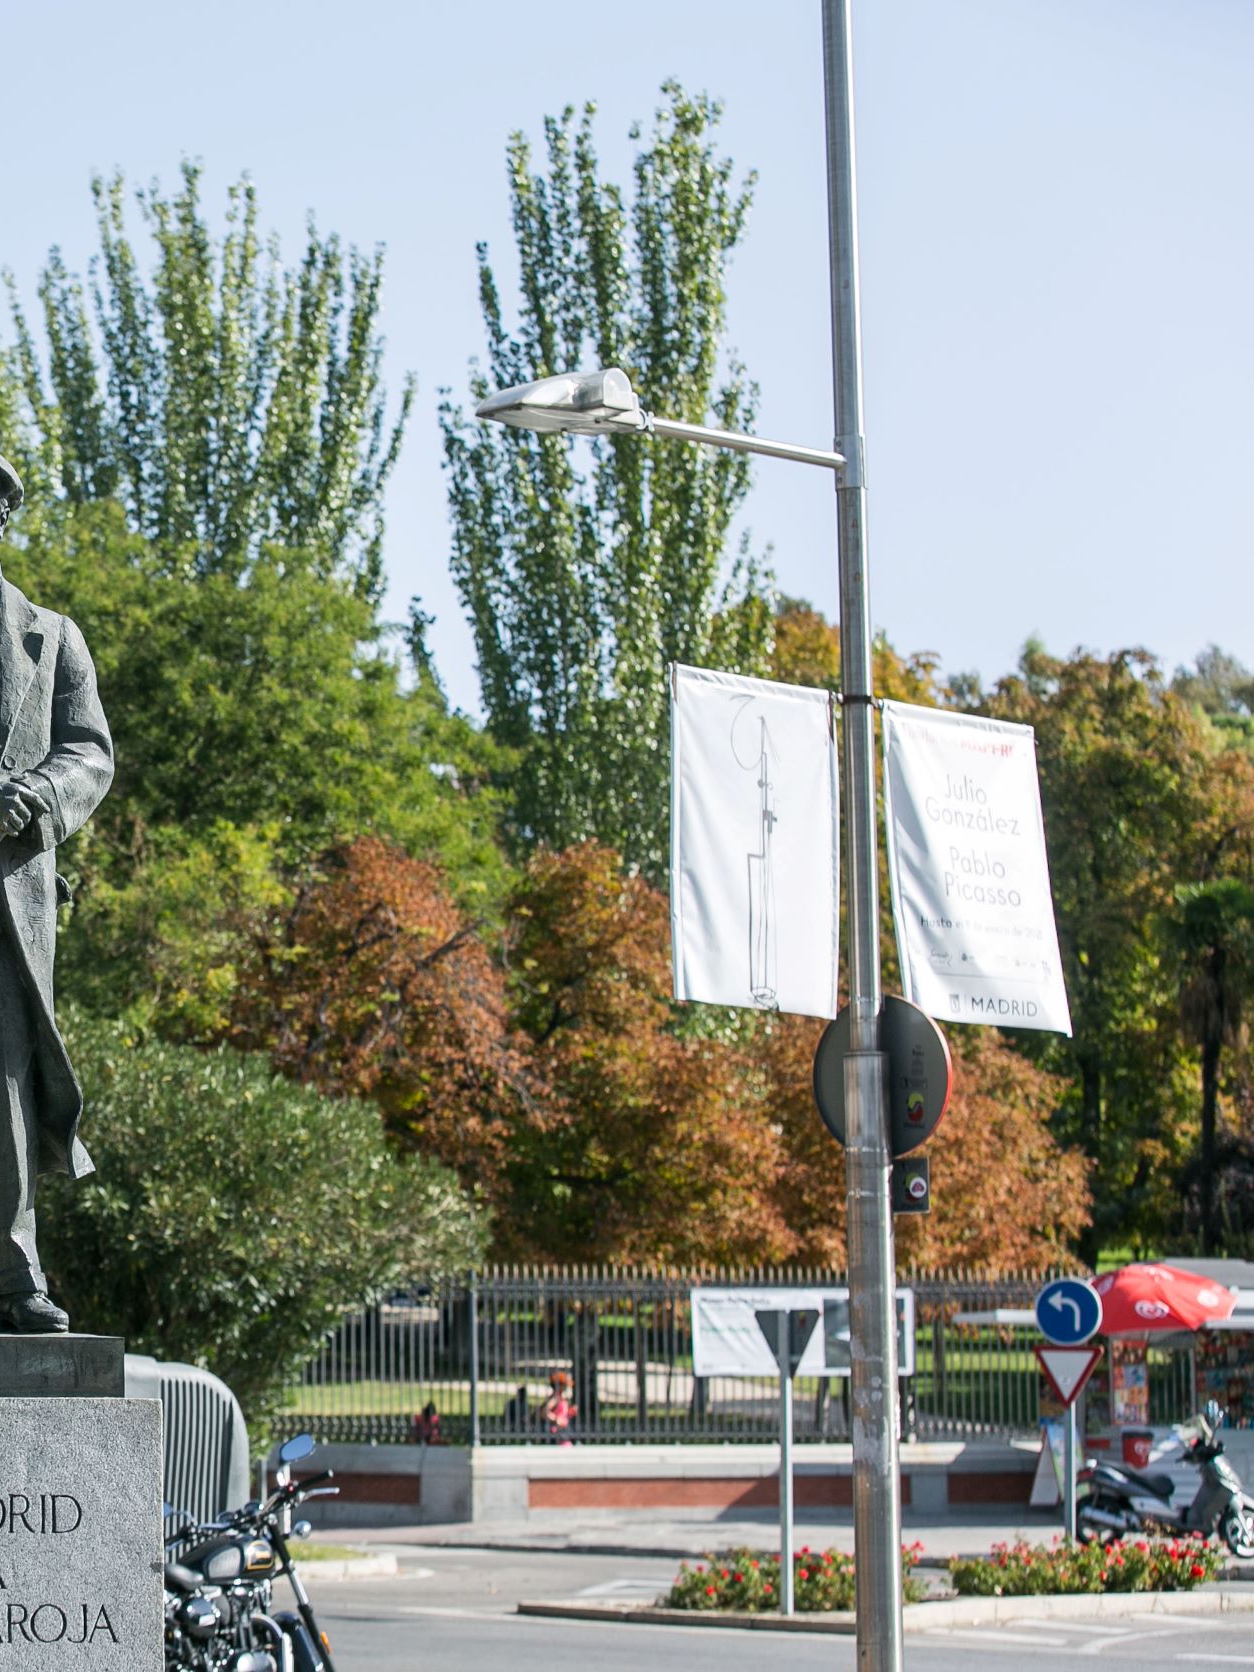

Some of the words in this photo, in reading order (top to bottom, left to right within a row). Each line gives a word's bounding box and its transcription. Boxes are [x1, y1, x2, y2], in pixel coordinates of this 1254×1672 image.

[945, 774, 988, 806] Julio
[924, 796, 1021, 837] González
[949, 846, 1006, 879] Pablo
[944, 871, 1022, 907] Picasso
[970, 996, 1038, 1017] MADRID
